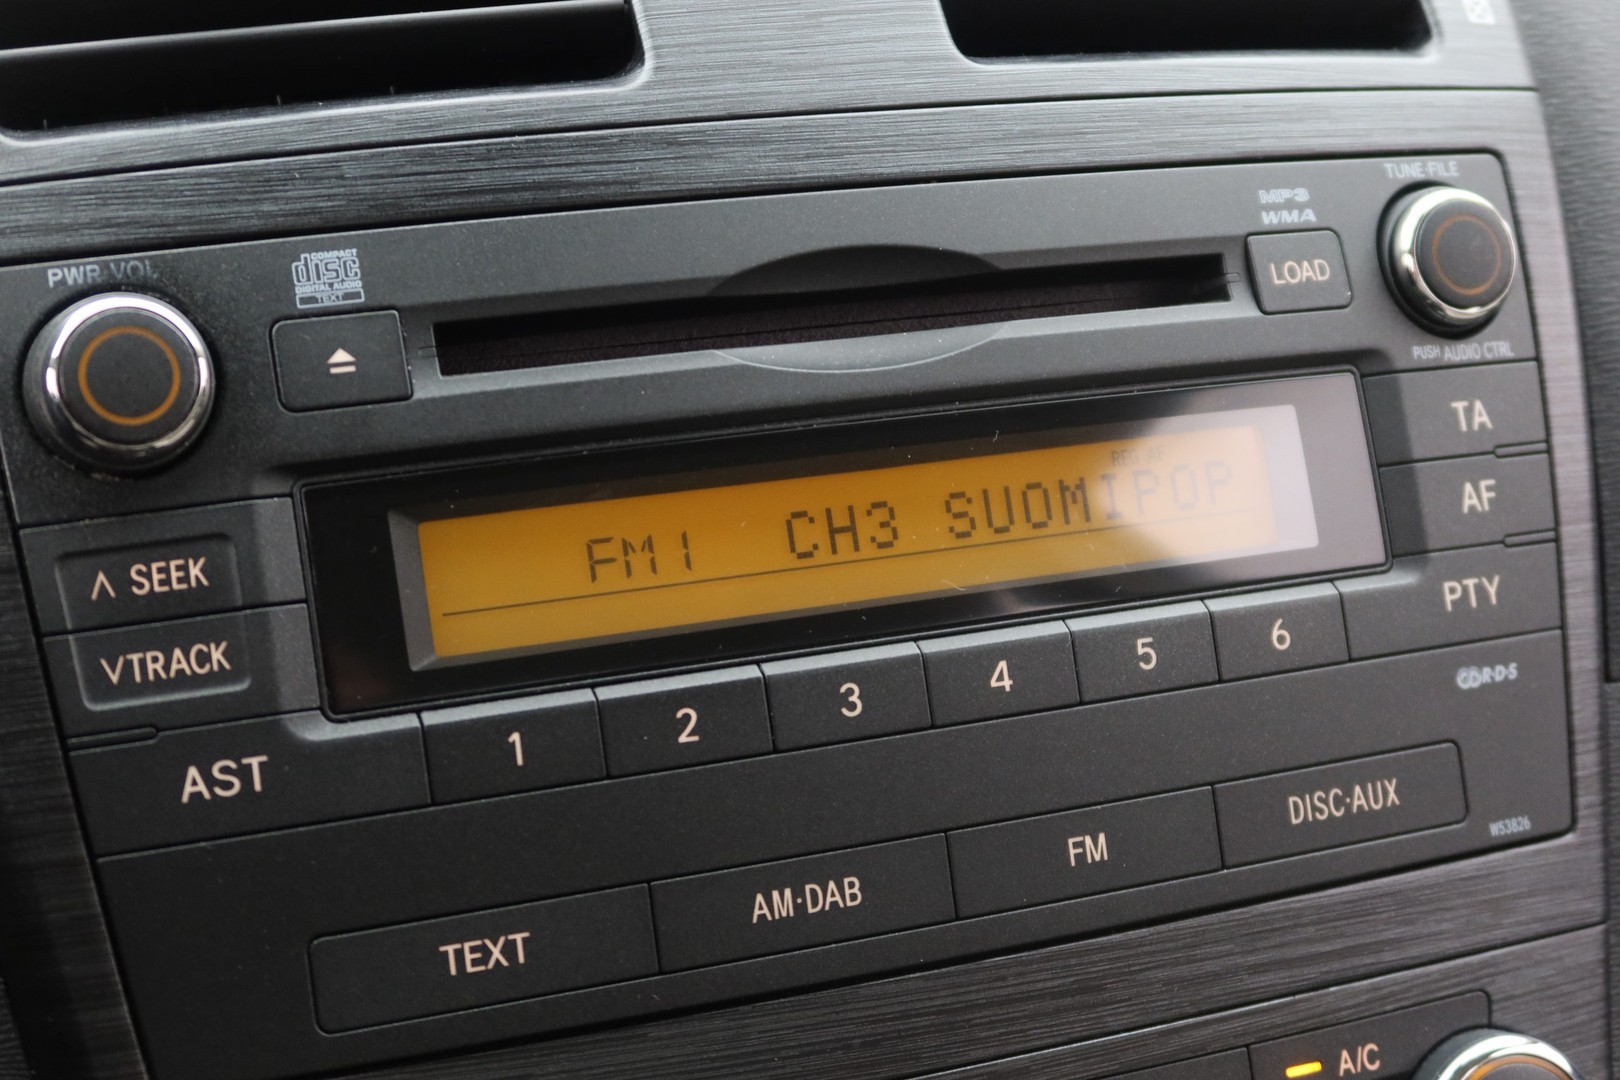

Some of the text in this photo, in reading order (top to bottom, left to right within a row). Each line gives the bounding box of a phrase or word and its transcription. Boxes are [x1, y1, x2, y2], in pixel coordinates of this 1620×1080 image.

[1258, 188, 1310, 203] MP3
[1261, 209, 1317, 224] WMA
[310, 248, 358, 260] COMPACT
[47, 264, 101, 288] PWR
[295, 280, 363, 294] DIGITAL AUDIO
[1270, 259, 1331, 286] LOAD
[1412, 340, 1516, 361] PUSH AUDIO CTRL
[1451, 399, 1494, 432] TA
[785, 501, 899, 560] CH3
[944, 459, 1234, 539] SUOMIPOP
[1461, 479, 1498, 515] AF
[129, 556, 210, 596] SEEK
[1442, 575, 1500, 613] PTY
[1270, 617, 1292, 651] 6
[1136, 637, 1159, 671] 5
[989, 660, 1014, 694] 4
[839, 682, 864, 718] 3
[675, 707, 701, 744] 2
[506, 731, 525, 767] 1
[180, 754, 270, 804] AST
[1066, 831, 1110, 867] FM
[438, 931, 532, 977] TEXT
[1337, 1042, 1382, 1078] A/C
